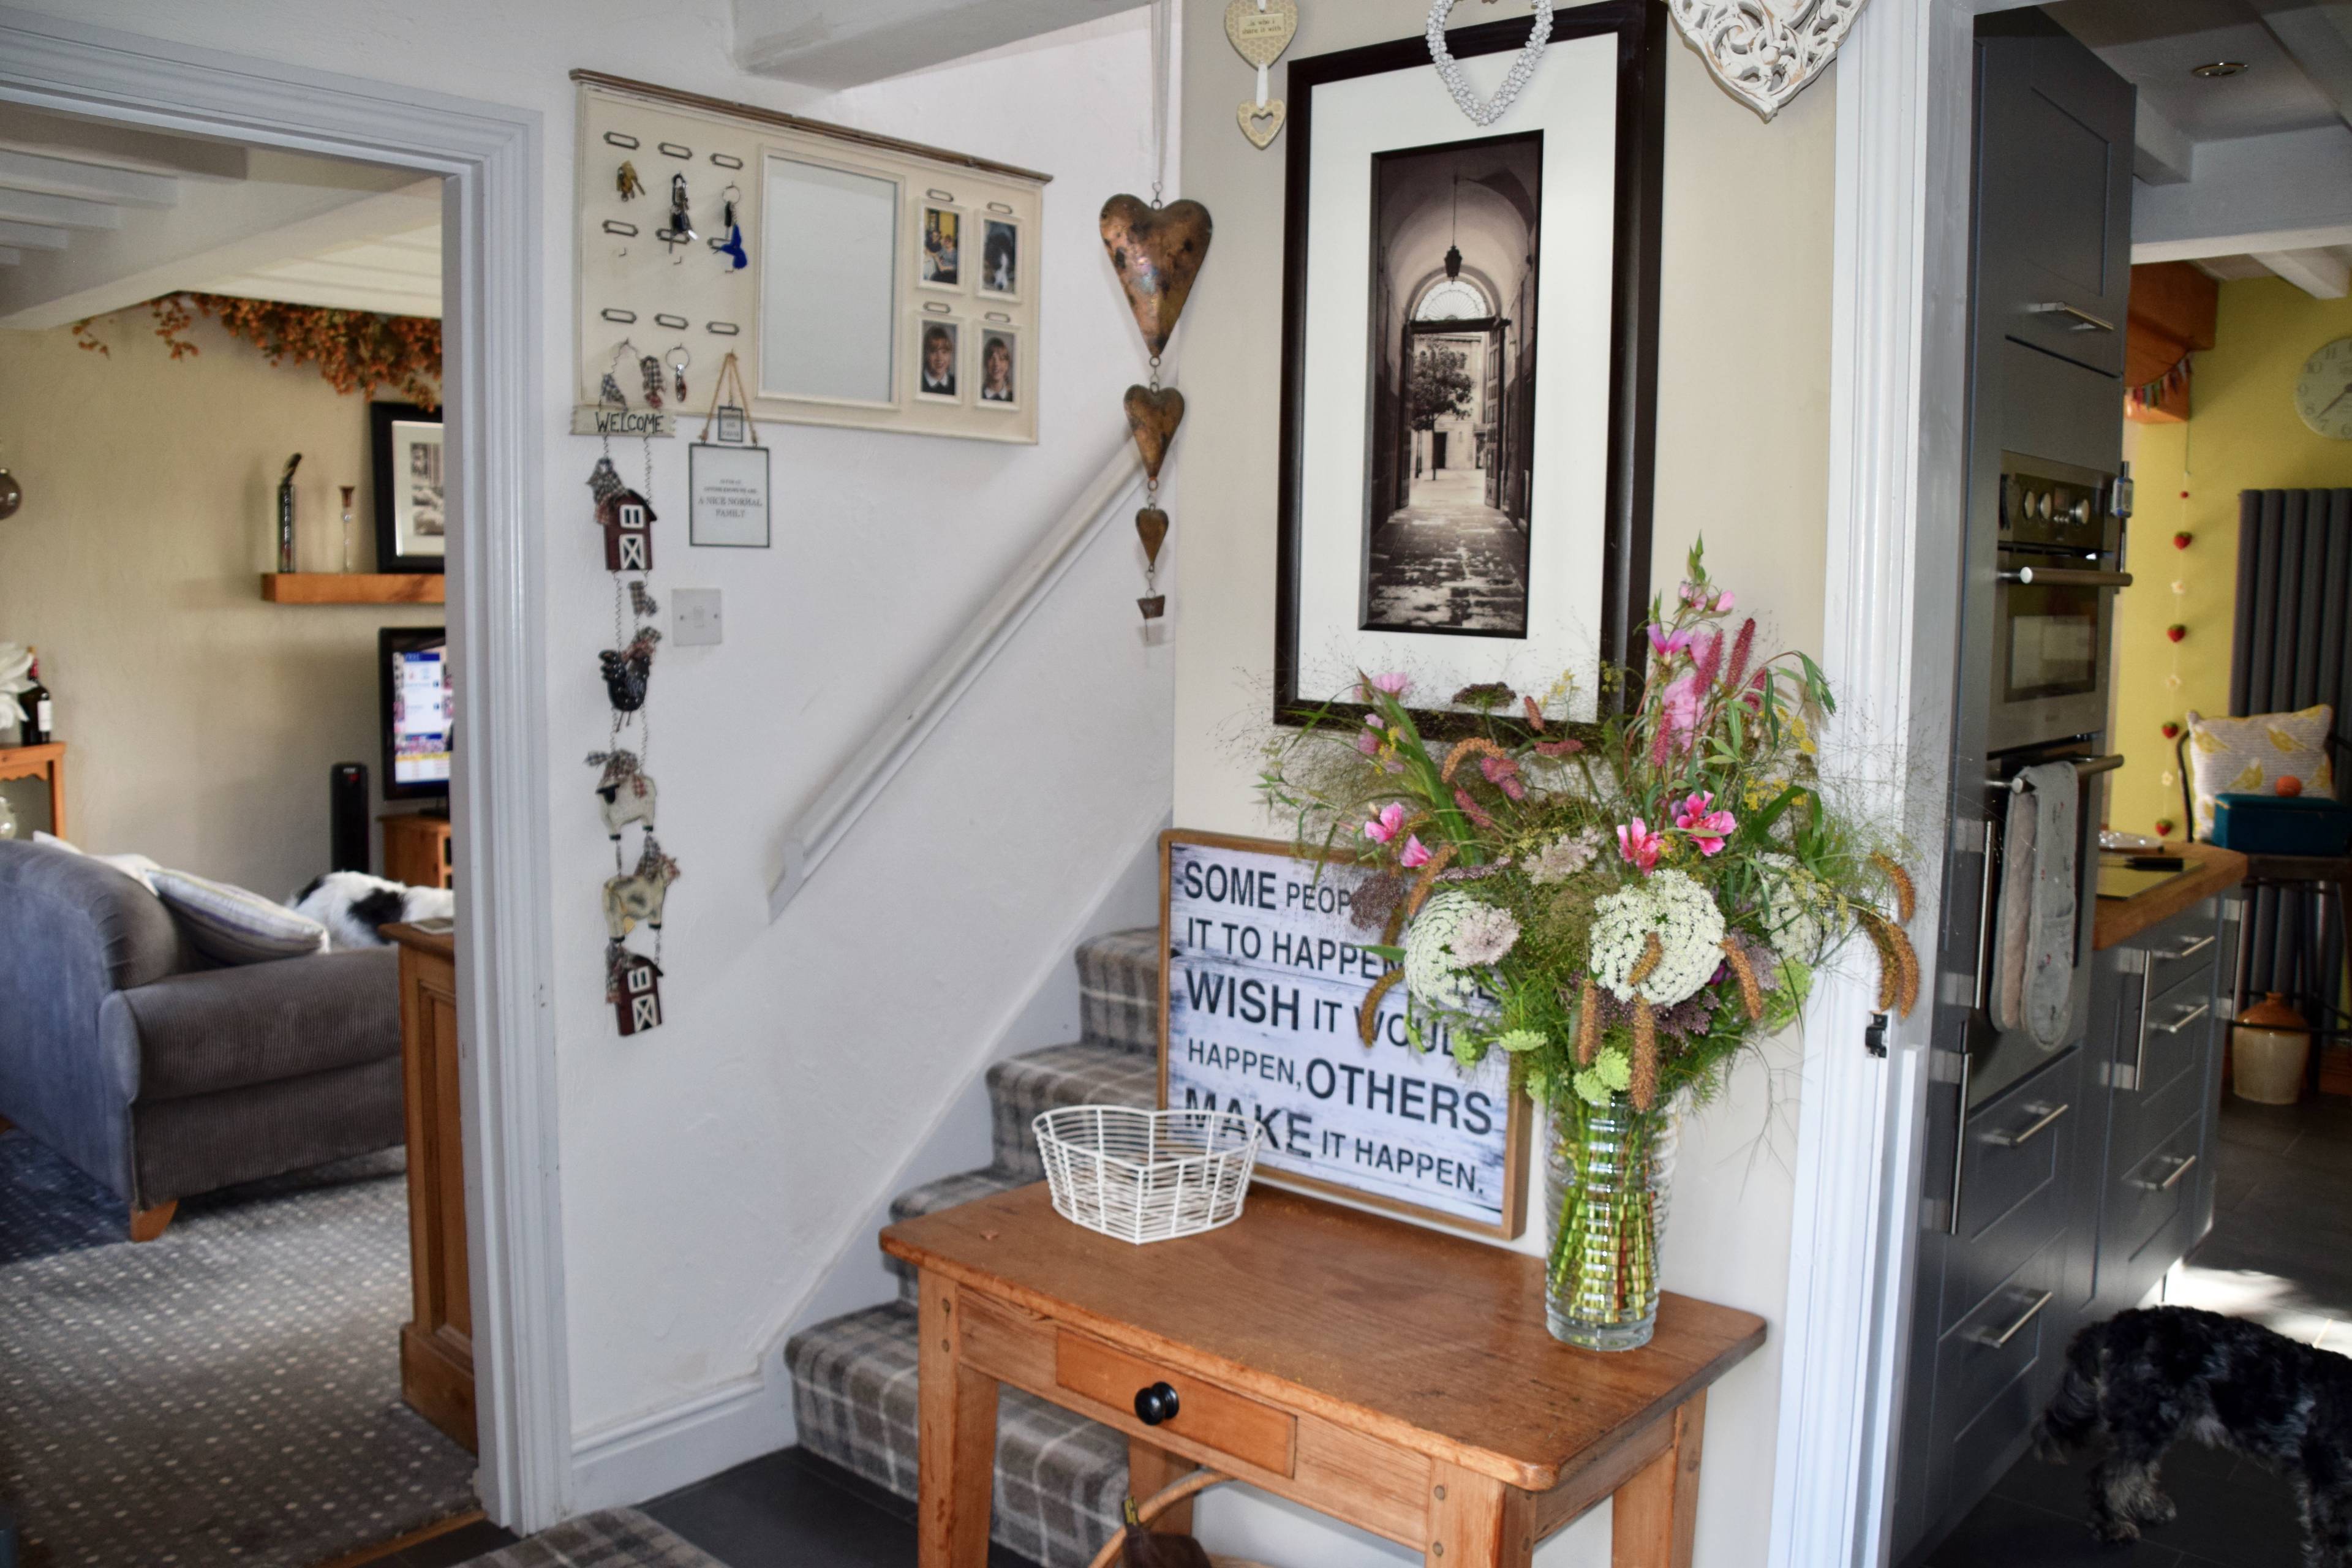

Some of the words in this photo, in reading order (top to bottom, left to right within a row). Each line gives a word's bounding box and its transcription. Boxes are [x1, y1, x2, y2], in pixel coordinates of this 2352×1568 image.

[595, 411, 665, 434] WELCOME
[1184, 861, 1276, 910] SOME
[1286, 881, 1352, 916] PEOP
[1188, 917, 1212, 950] IT
[1222, 923, 1262, 959] TO
[1185, 969, 1300, 1031] WISH
[1314, 999, 1342, 1033] IT
[1354, 1006, 1490, 1063] WOUL
[1188, 1038, 1302, 1092] HAPPEN,
[1306, 1058, 1492, 1136] OTHERS
[1185, 1087, 1313, 1159] MAKE
[1322, 1129, 1346, 1158] IT
[1355, 1137, 1483, 1195] HAPPEN.
